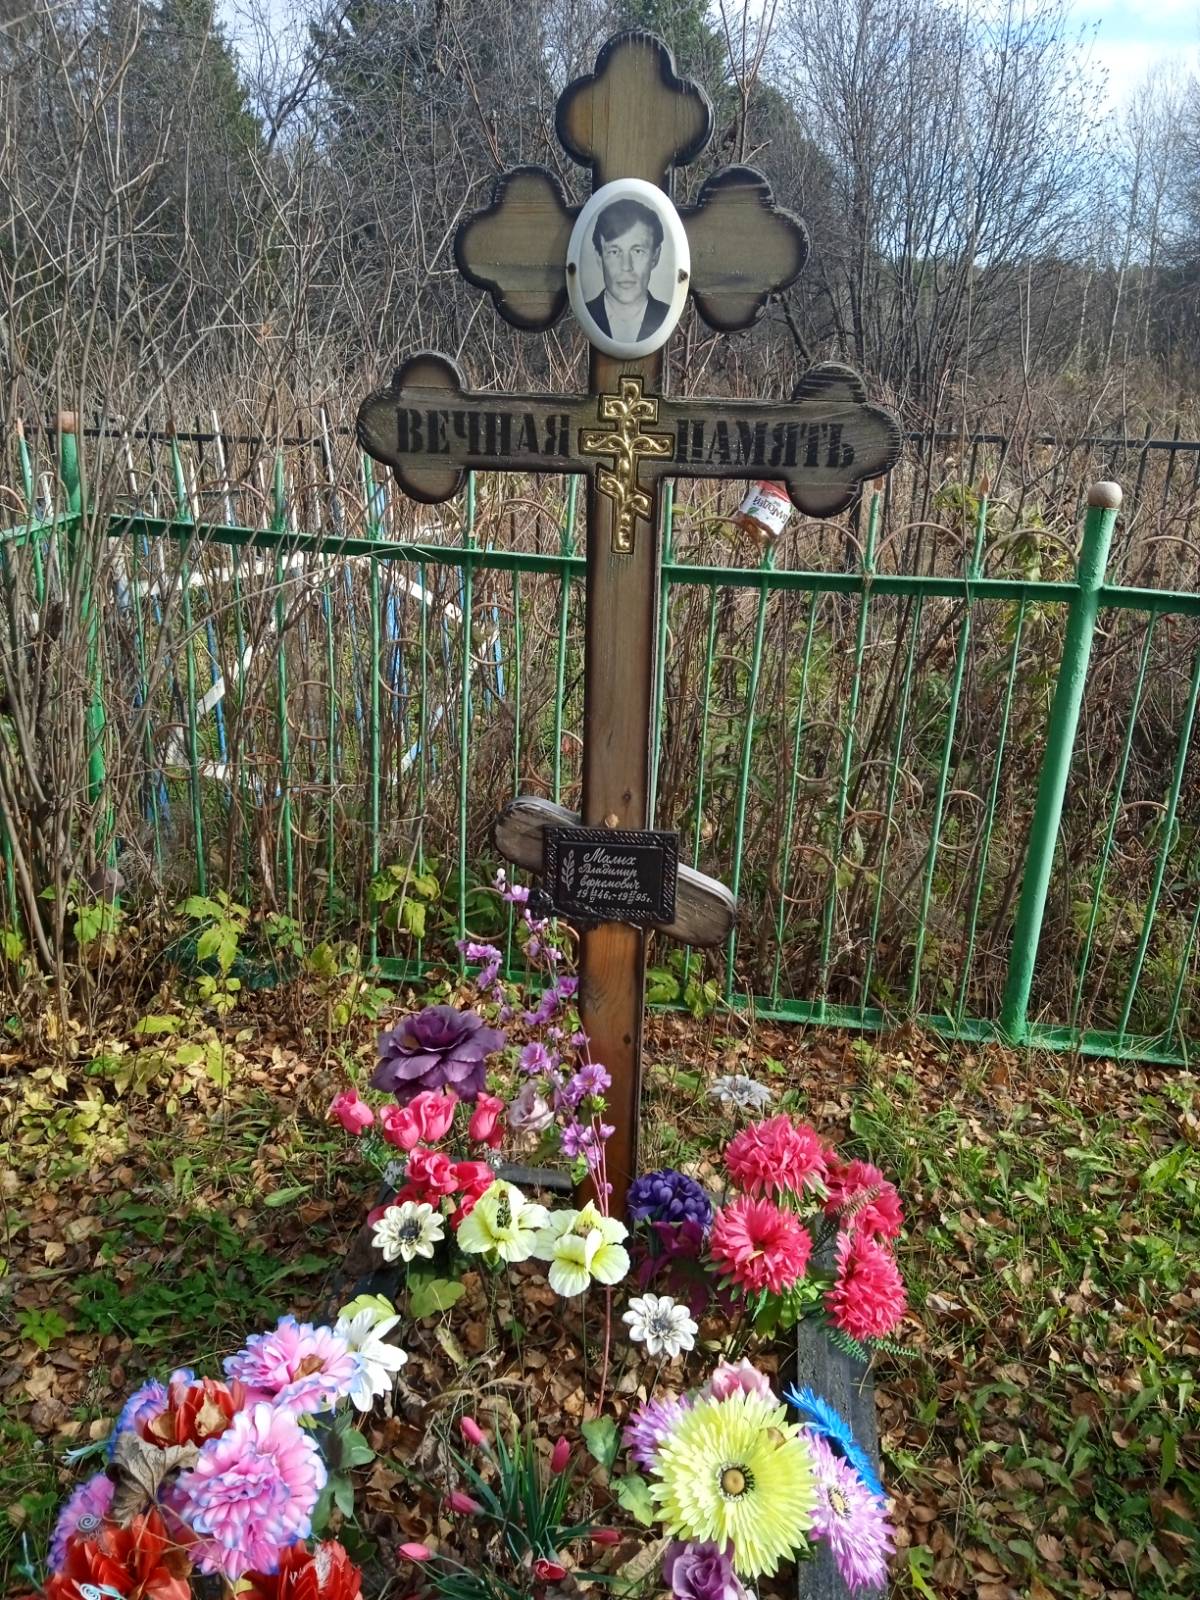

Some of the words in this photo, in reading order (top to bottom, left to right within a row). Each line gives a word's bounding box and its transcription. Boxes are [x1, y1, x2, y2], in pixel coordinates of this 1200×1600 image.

[396, 408, 571, 458] ВЕЧНАЯ
[675, 419, 855, 467] ПАМЯТЬ
[583, 847, 637, 865] Малых
[578, 863, 638, 879] Владимир
